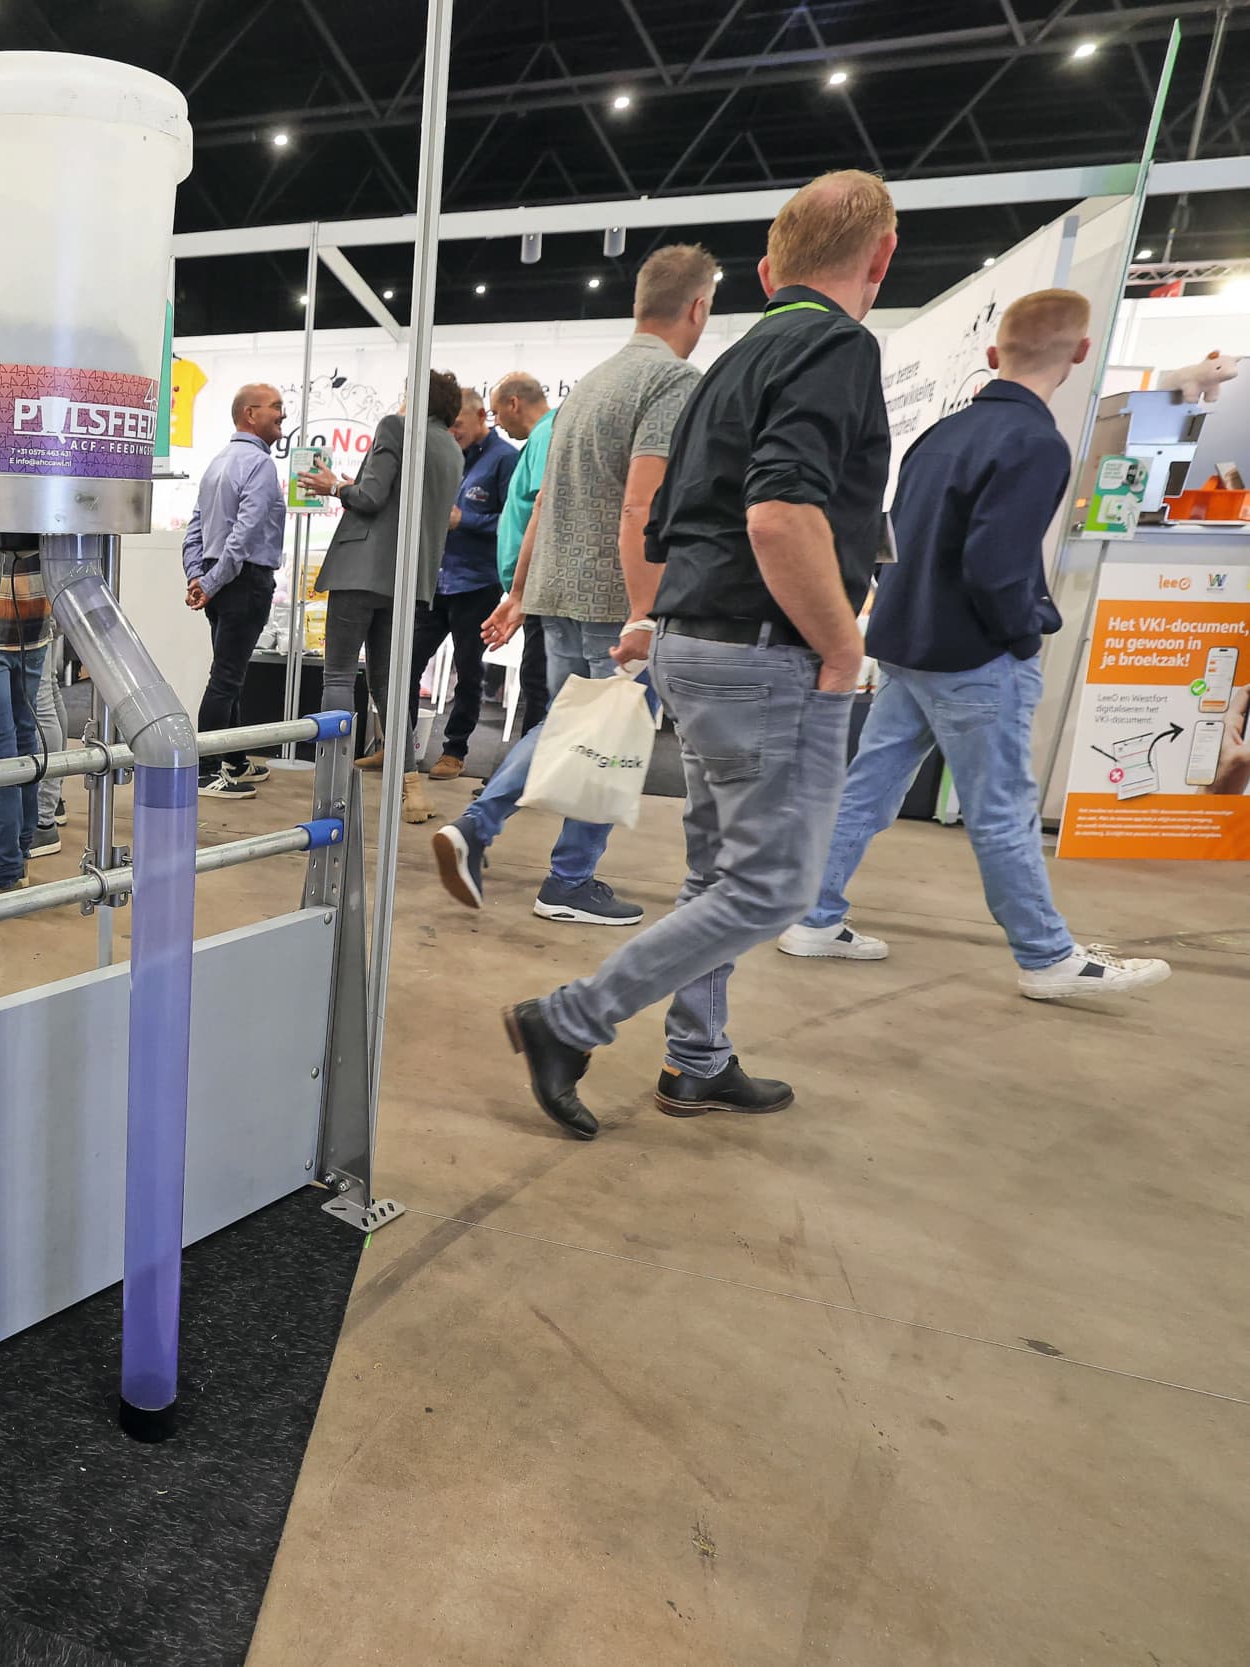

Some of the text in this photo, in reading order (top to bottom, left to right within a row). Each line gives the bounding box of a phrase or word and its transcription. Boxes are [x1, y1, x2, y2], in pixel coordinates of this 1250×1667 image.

[70, 440, 96, 451] ACF
[1108, 616, 1250, 637] Het VKI-document,
[1105, 636, 1202, 653] nu gewoon in
[1100, 652, 1191, 669] je broekzak!
